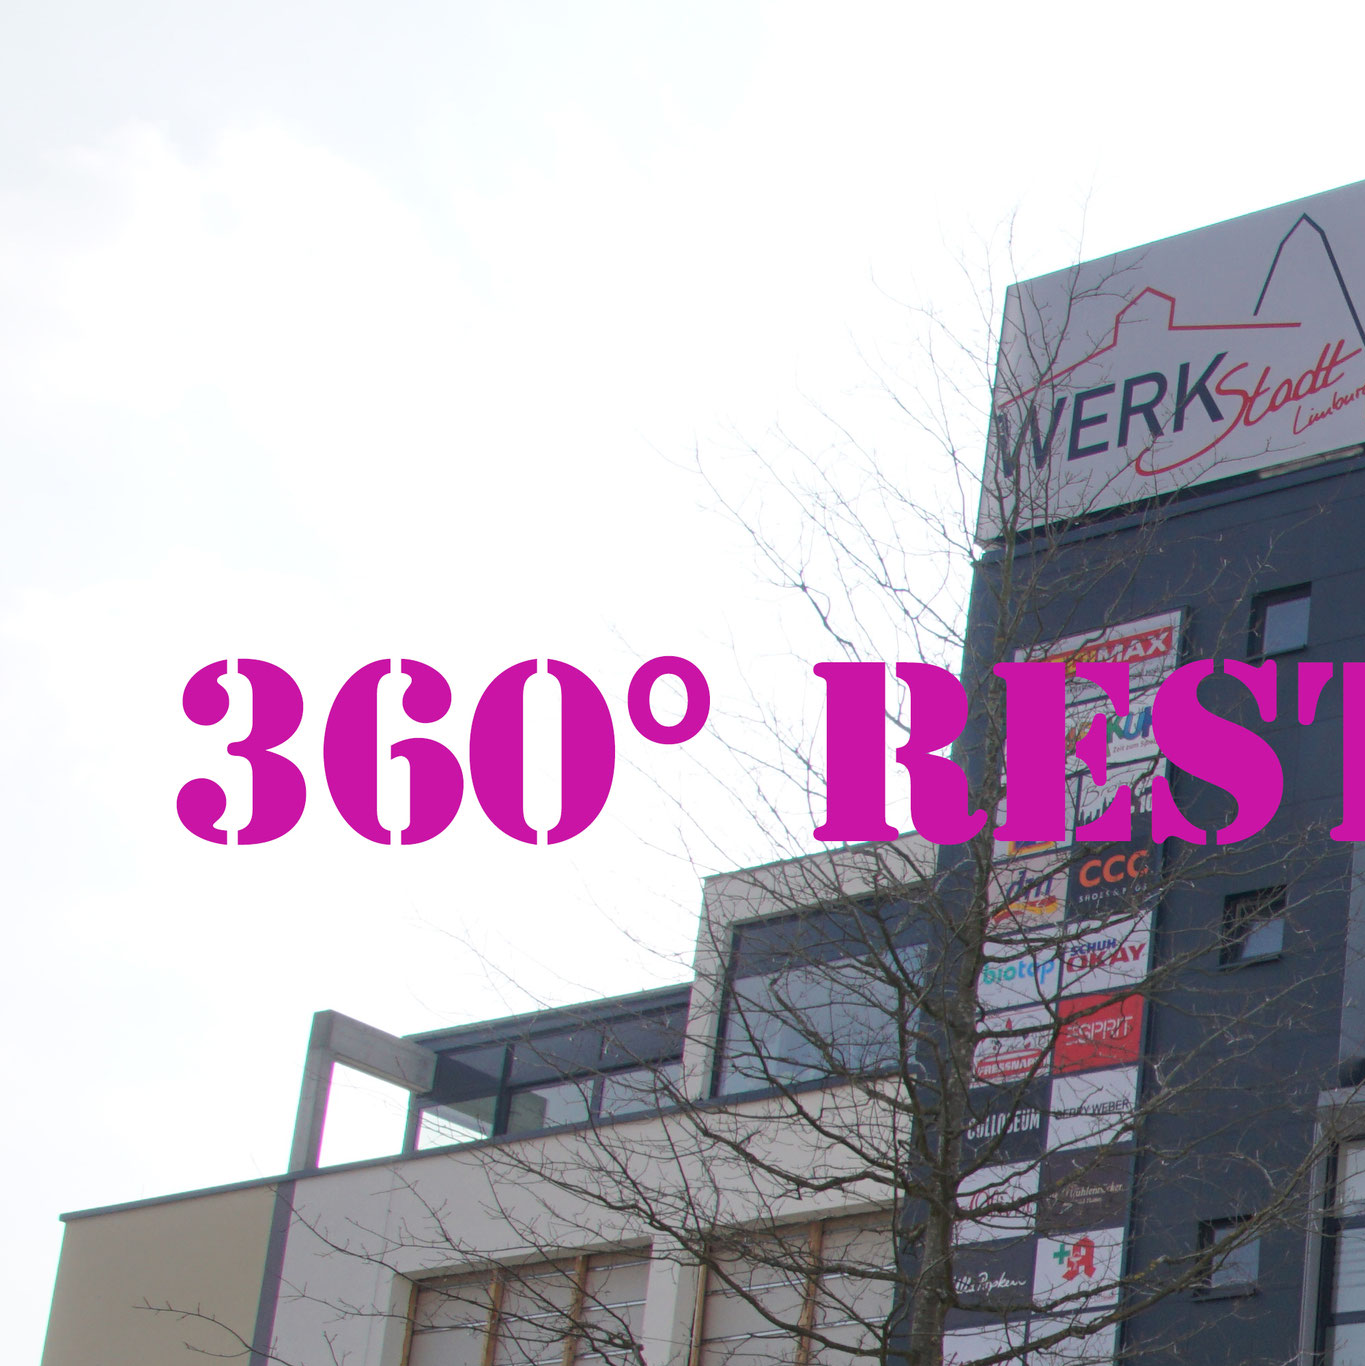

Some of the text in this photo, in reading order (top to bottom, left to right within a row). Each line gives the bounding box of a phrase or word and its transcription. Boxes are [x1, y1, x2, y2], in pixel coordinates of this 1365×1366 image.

[1079, 849, 1150, 888] CCC
[1066, 943, 1147, 974] OKAY
[1064, 1014, 1134, 1047] ESPRIT
[977, 1057, 1044, 1075] FRESSNAP
